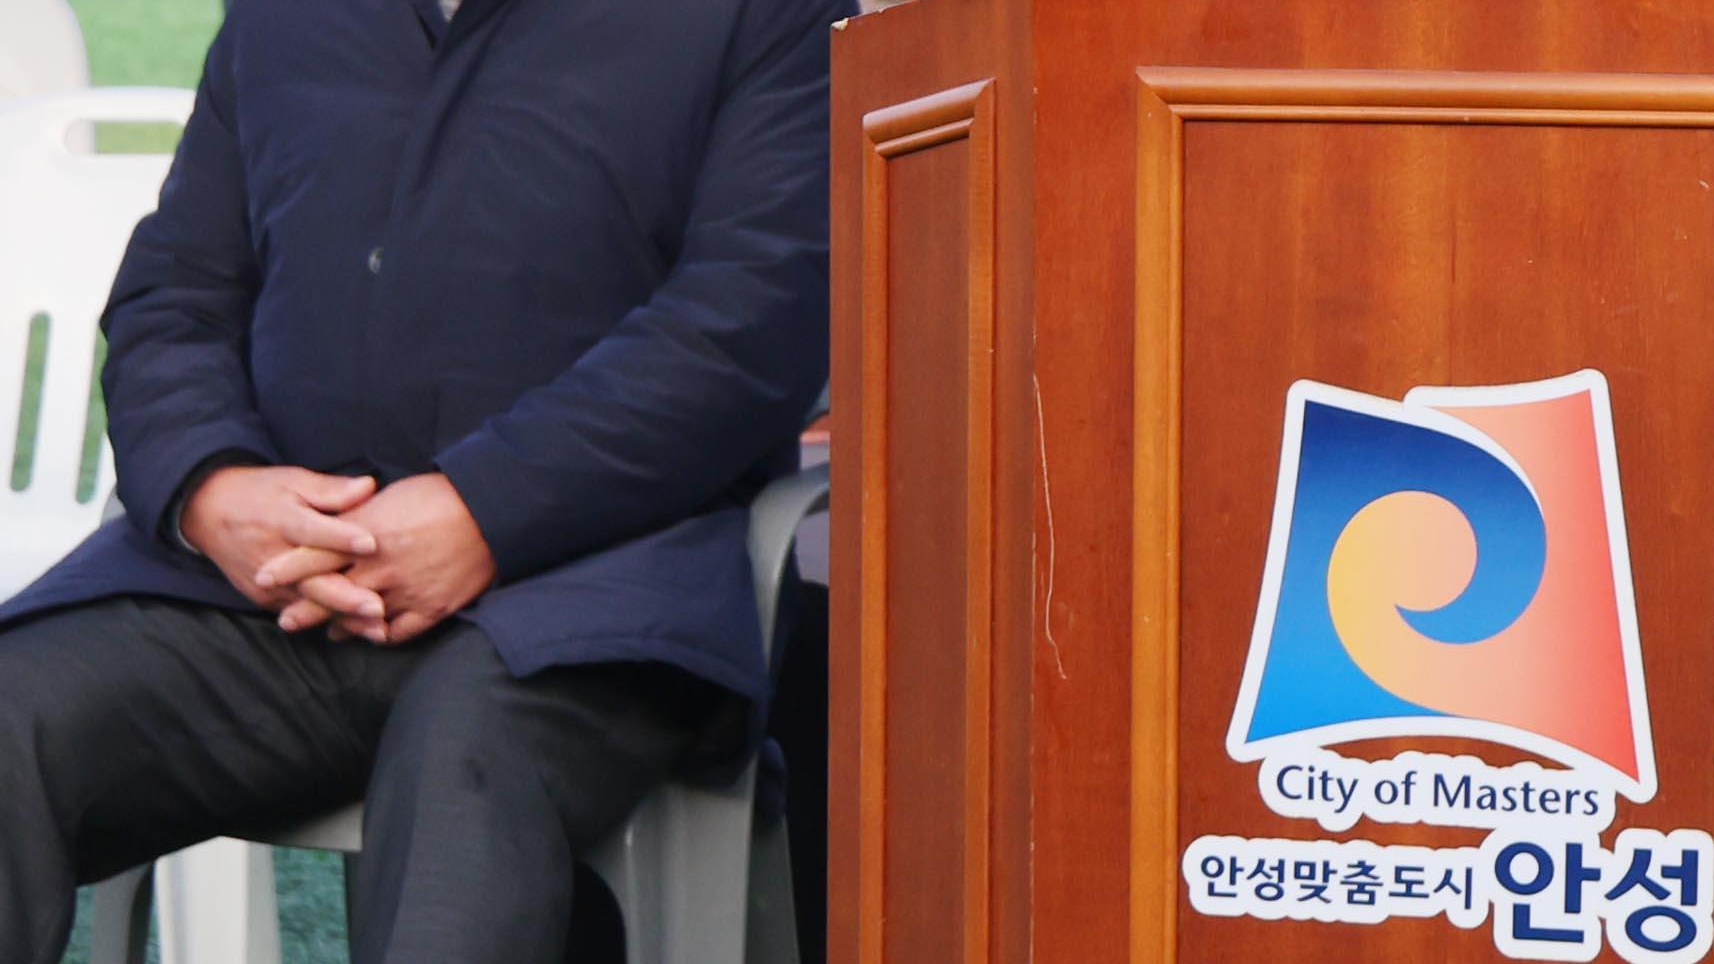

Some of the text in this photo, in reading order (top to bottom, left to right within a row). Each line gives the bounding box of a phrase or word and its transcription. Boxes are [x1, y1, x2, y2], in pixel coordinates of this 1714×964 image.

[1276, 765, 1600, 816] City of Masters
[1199, 841, 1701, 954] 안성맞춤도시 안성
